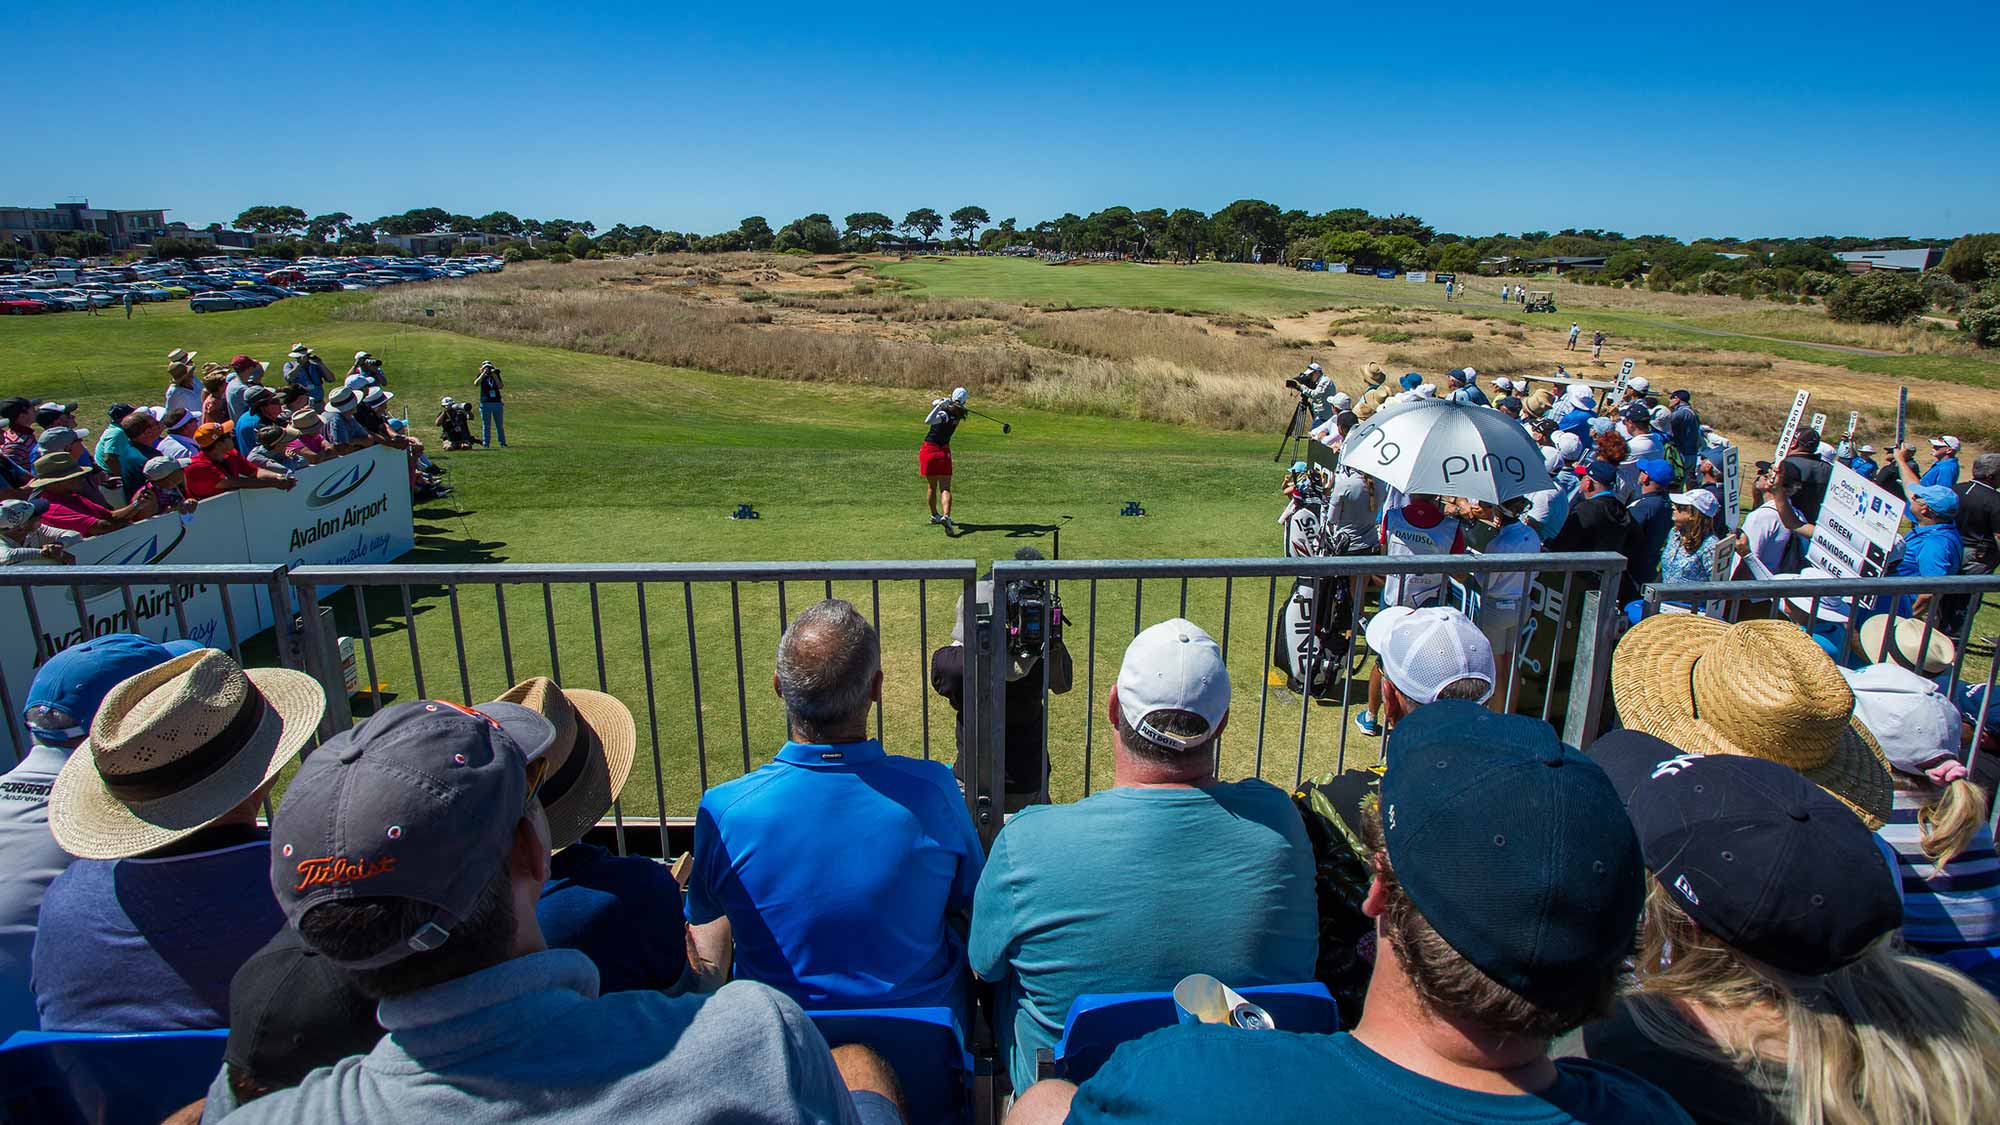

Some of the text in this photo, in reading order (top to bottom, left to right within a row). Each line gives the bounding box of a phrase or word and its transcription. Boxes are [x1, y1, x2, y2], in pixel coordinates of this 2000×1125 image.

[1617, 361, 1633, 394] QUIET
[1779, 393, 1806, 457] NO CAMERAS
[1727, 453, 1738, 515] QUIET
[289, 492, 388, 553] Avalon Airport
[1829, 518, 1853, 541] GREEN
[1817, 535, 1855, 569] DAVIDSON
[1820, 557, 1842, 578] M LEE
[1141, 725, 1158, 739] JUST
[1158, 734, 1169, 743] DO
